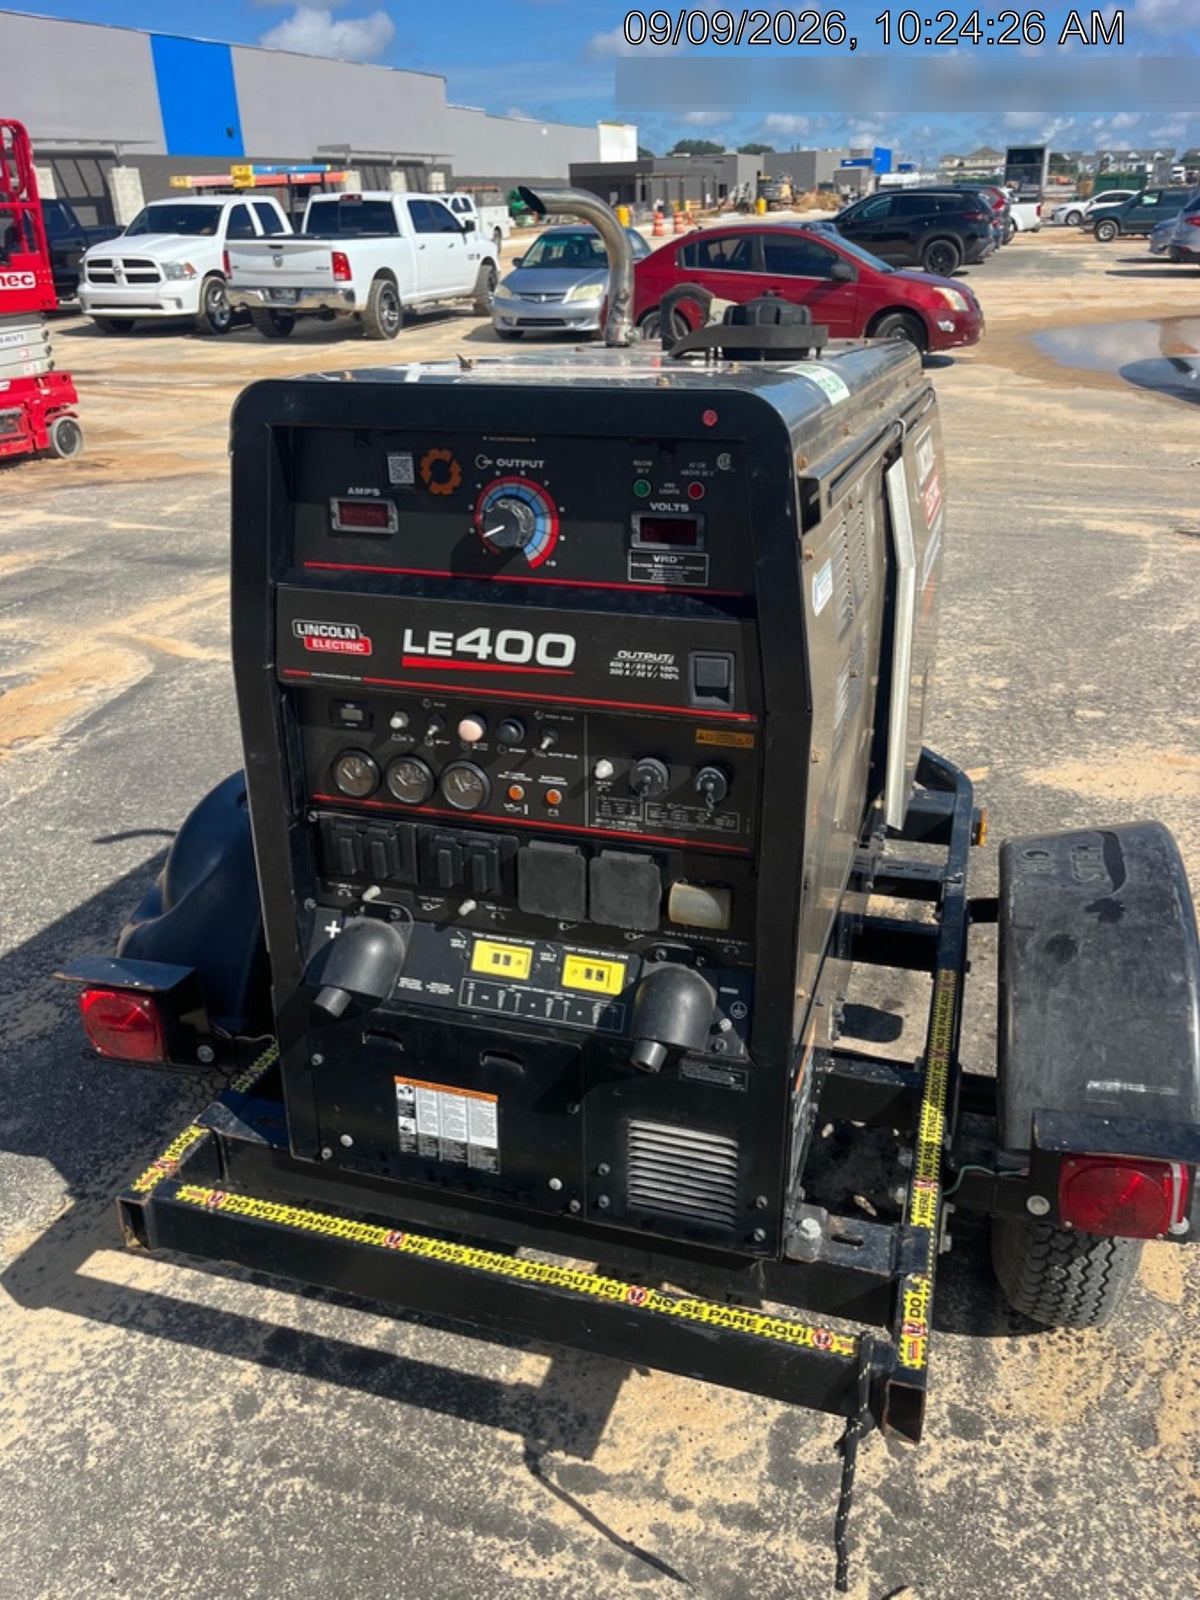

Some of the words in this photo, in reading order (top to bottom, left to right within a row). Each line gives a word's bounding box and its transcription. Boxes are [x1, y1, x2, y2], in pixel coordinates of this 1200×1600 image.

[496, 457, 546, 469] OUTPUT
[347, 487, 381, 497] AMPS
[650, 502, 690, 512] VOLTS
[296, 623, 357, 640] LINCOLN
[312, 639, 365, 653] ELECTRIC
[402, 627, 577, 668] LE400
[927, 1109, 938, 1139] TENEZ
[918, 1191, 930, 1218] HERE
[226, 1197, 250, 1209] DO
[253, 1202, 283, 1218] NOT
[286, 1210, 338, 1230] STAND
[340, 1222, 385, 1240] HERE
[406, 1239, 428, 1250] NE
[431, 1243, 464, 1259] PAS
[467, 1252, 521, 1272] TENEZ
[524, 1265, 595, 1287] DEBOUT
[600, 1283, 623, 1295] ICI
[650, 1295, 677, 1309] NO
[680, 1303, 704, 1315] SE
[708, 1309, 760, 1329] PARE
[909, 1297, 922, 1318] DO
